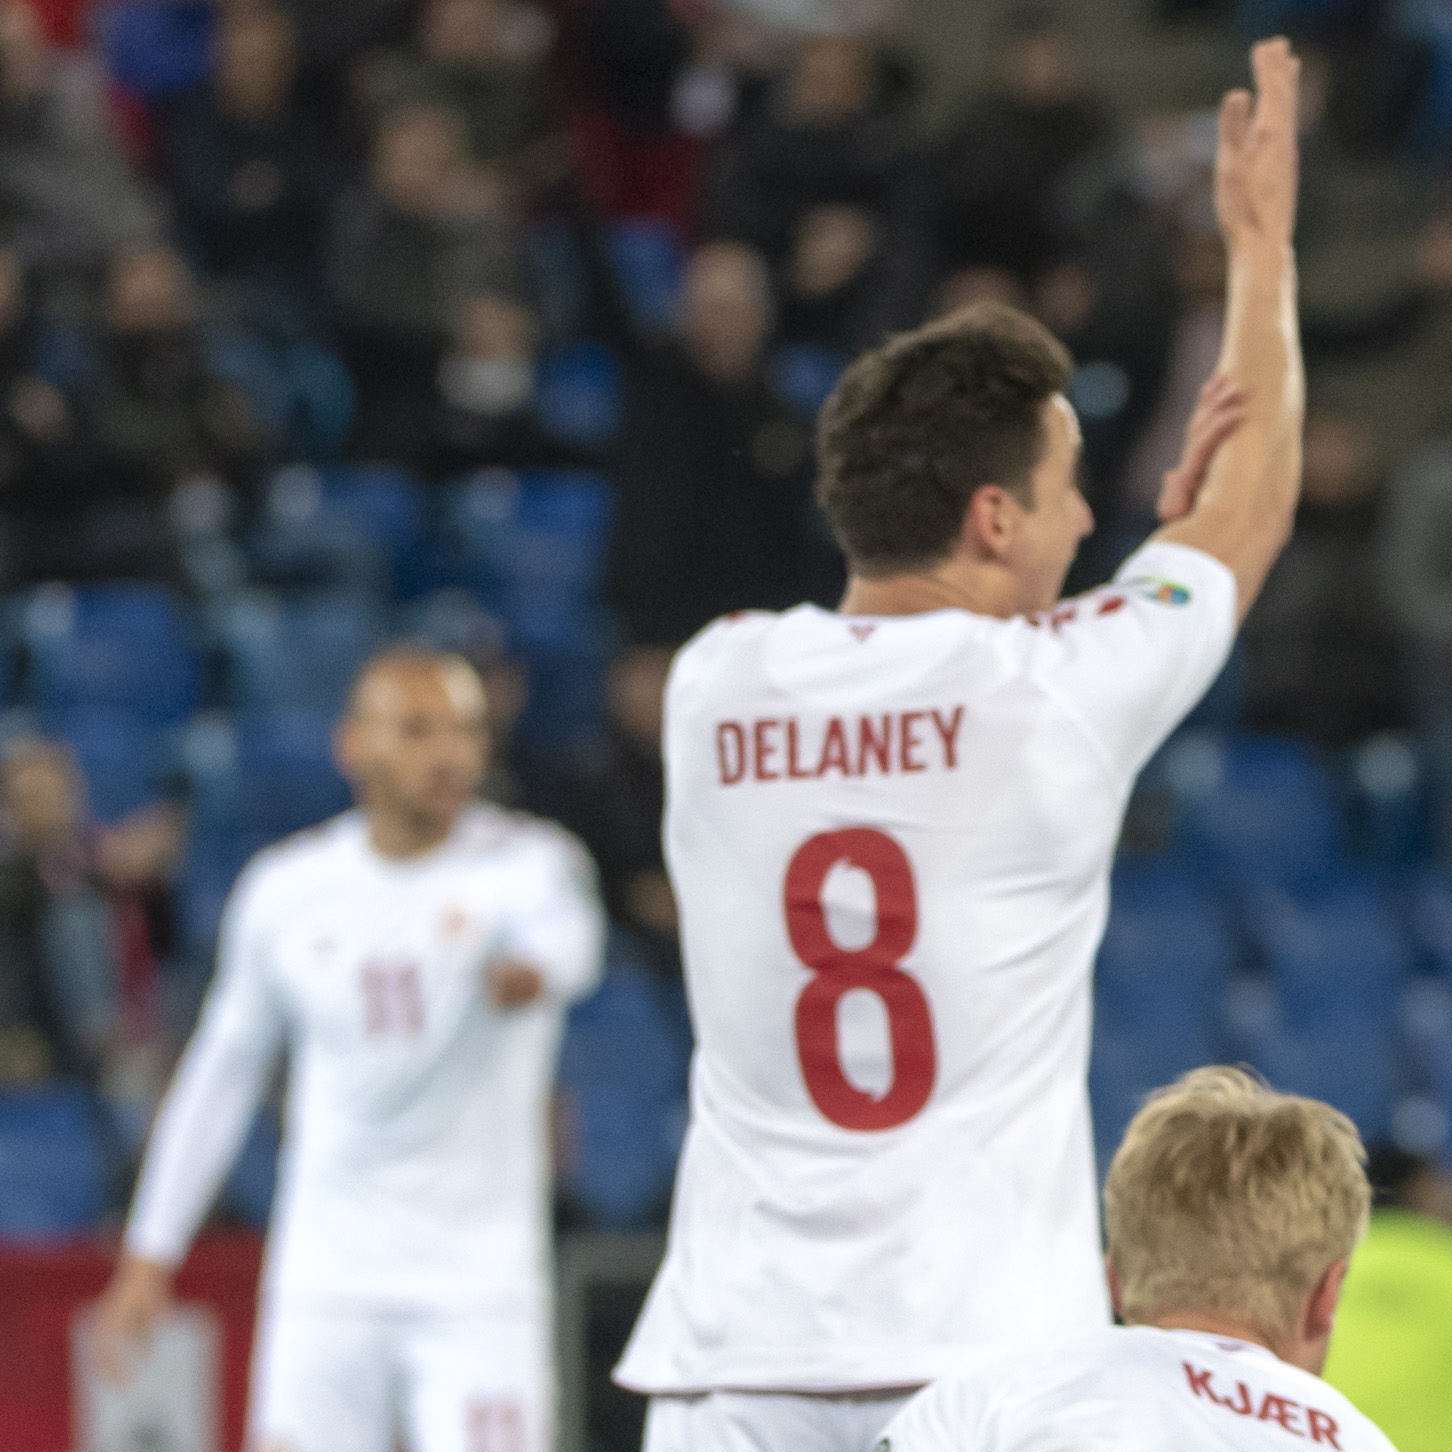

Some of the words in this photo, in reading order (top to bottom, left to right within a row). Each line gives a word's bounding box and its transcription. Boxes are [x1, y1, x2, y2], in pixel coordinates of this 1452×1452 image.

[716, 704, 964, 786] DELANEY
[783, 825, 938, 1133] 8
[1181, 1360, 1343, 1452] KJÆR
